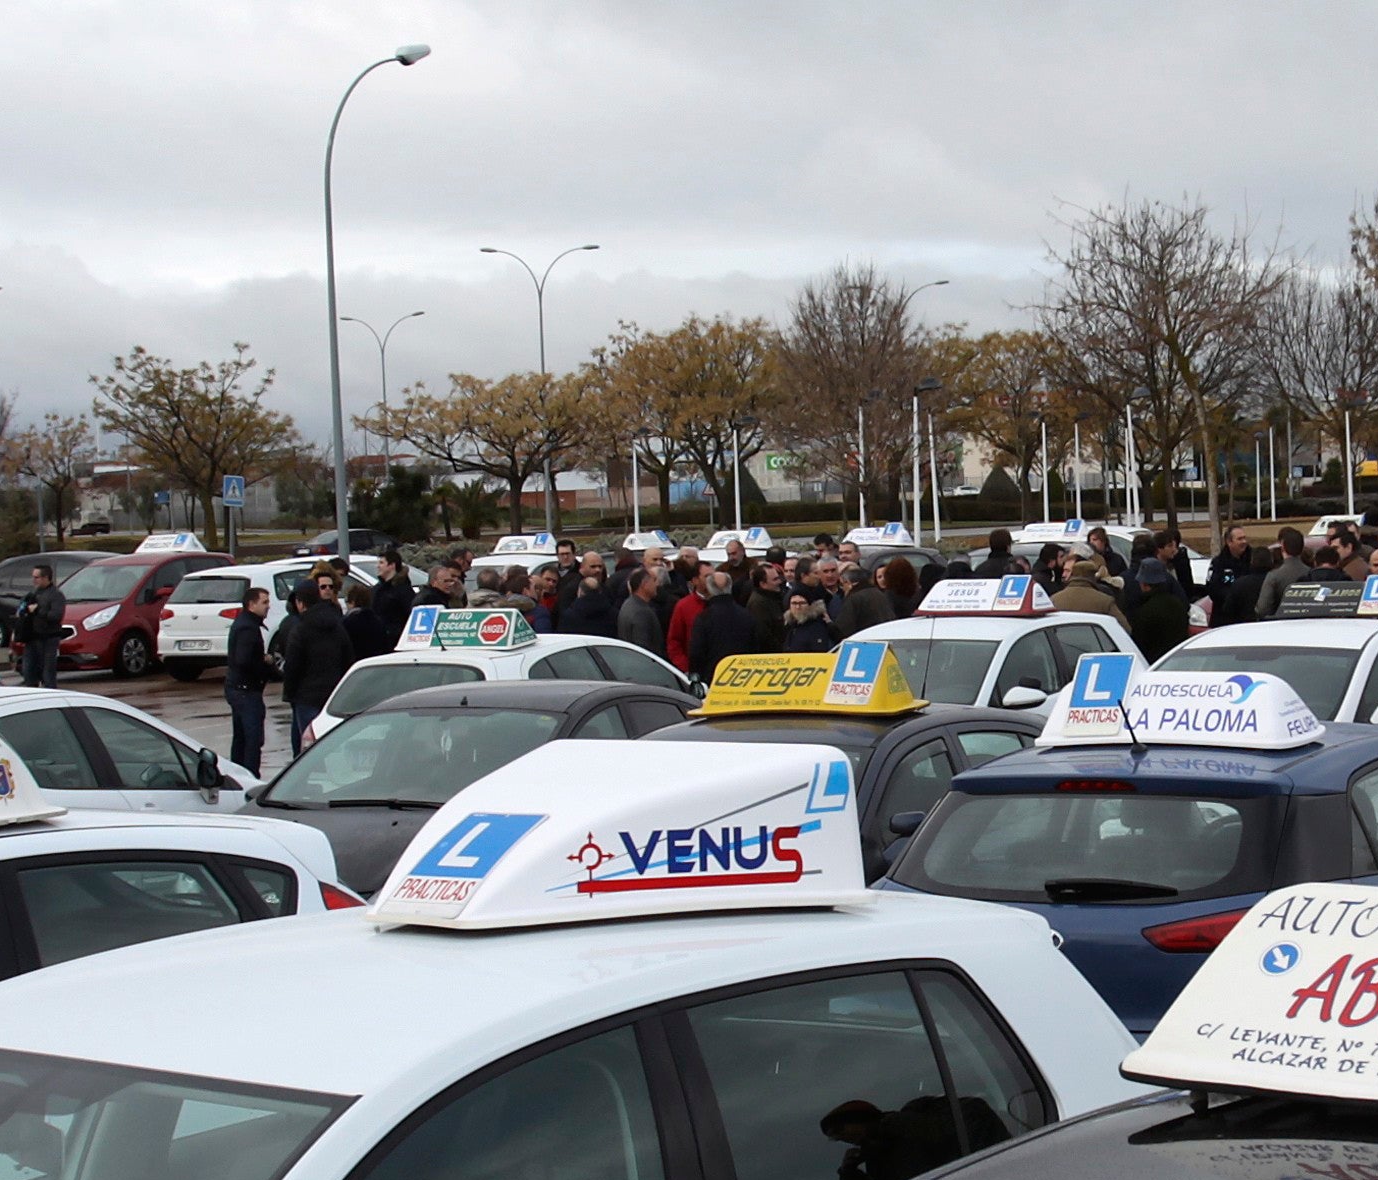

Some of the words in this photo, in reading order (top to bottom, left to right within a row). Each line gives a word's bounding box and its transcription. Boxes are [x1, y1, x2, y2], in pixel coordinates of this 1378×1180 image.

[1004, 579, 1018, 596] L
[414, 611, 427, 631] L
[844, 647, 866, 679] L
[714, 658, 828, 695] berrogar
[1083, 663, 1111, 701] L
[829, 682, 871, 697] PRACTICAS
[1131, 684, 1234, 698] AUTOESCUELA
[1067, 707, 1120, 725] PRACTICAS
[1158, 709, 1259, 733] PALOMA
[437, 821, 490, 868] L
[618, 825, 803, 877] VENUS
[392, 877, 477, 902] PRACTICAS
[1229, 1026, 1327, 1053] LEVANTE,
[1232, 1048, 1327, 1071] ALCAZAR
[1338, 1059, 1369, 1074] DE
